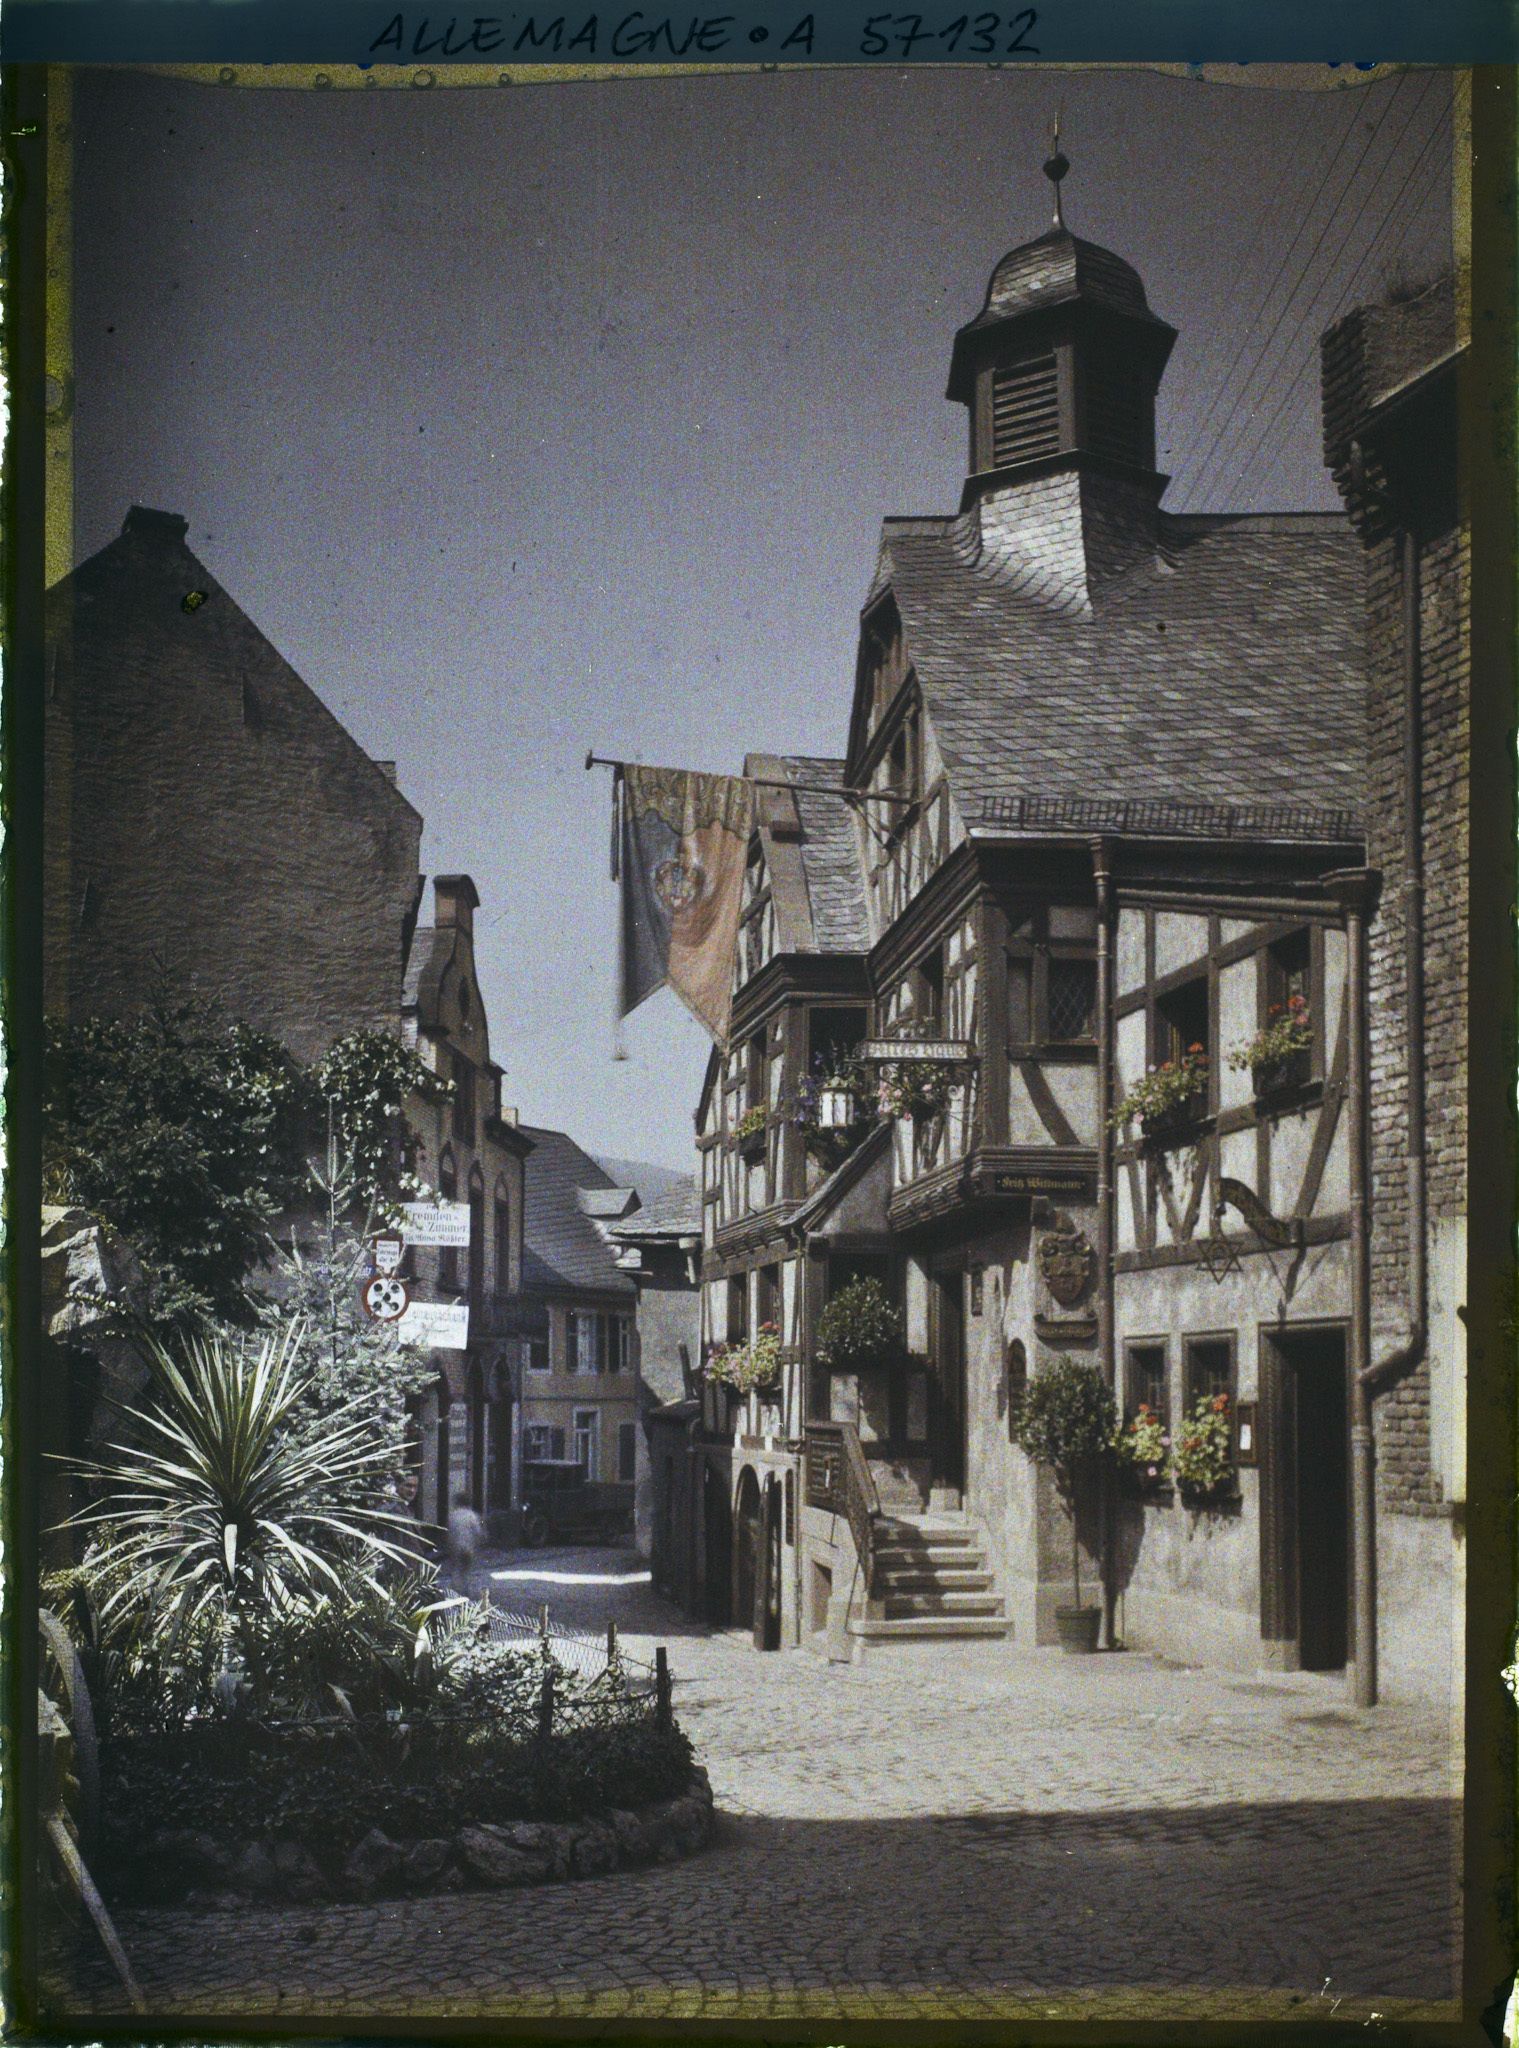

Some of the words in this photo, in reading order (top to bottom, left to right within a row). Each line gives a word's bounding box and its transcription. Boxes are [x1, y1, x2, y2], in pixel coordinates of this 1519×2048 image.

[368, 11, 737, 56] ALLEMAGNE
[780, 13, 815, 55] A
[860, 8, 1041, 56] 57132
